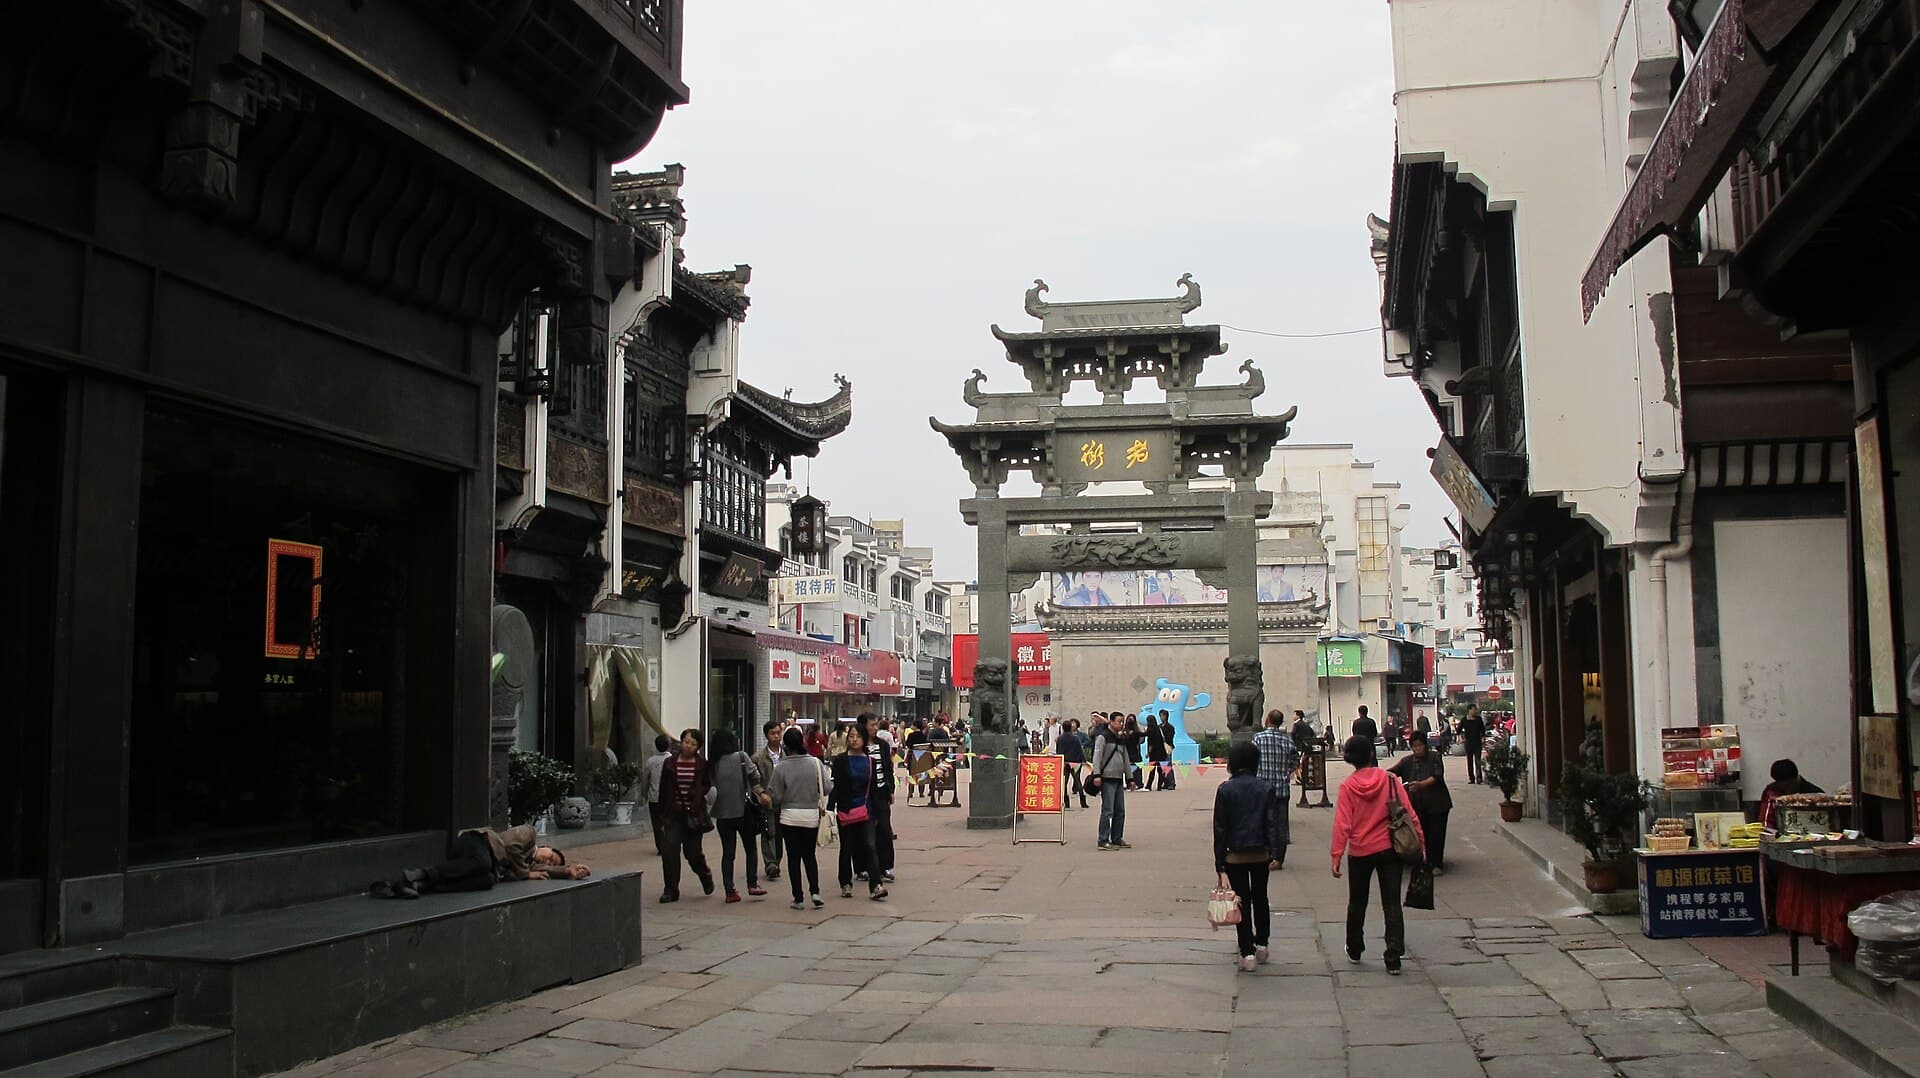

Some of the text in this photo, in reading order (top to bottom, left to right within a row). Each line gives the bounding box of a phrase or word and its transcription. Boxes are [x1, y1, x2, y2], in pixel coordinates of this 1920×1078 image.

[794, 578, 836, 596] 招待所
[1024, 761, 1040, 807] 请勿靠近
[1041, 761, 1056, 808] 安全维修
[1666, 891, 1745, 905] 携程等多家网
[1659, 908, 1719, 921] 站推荐餐饮
